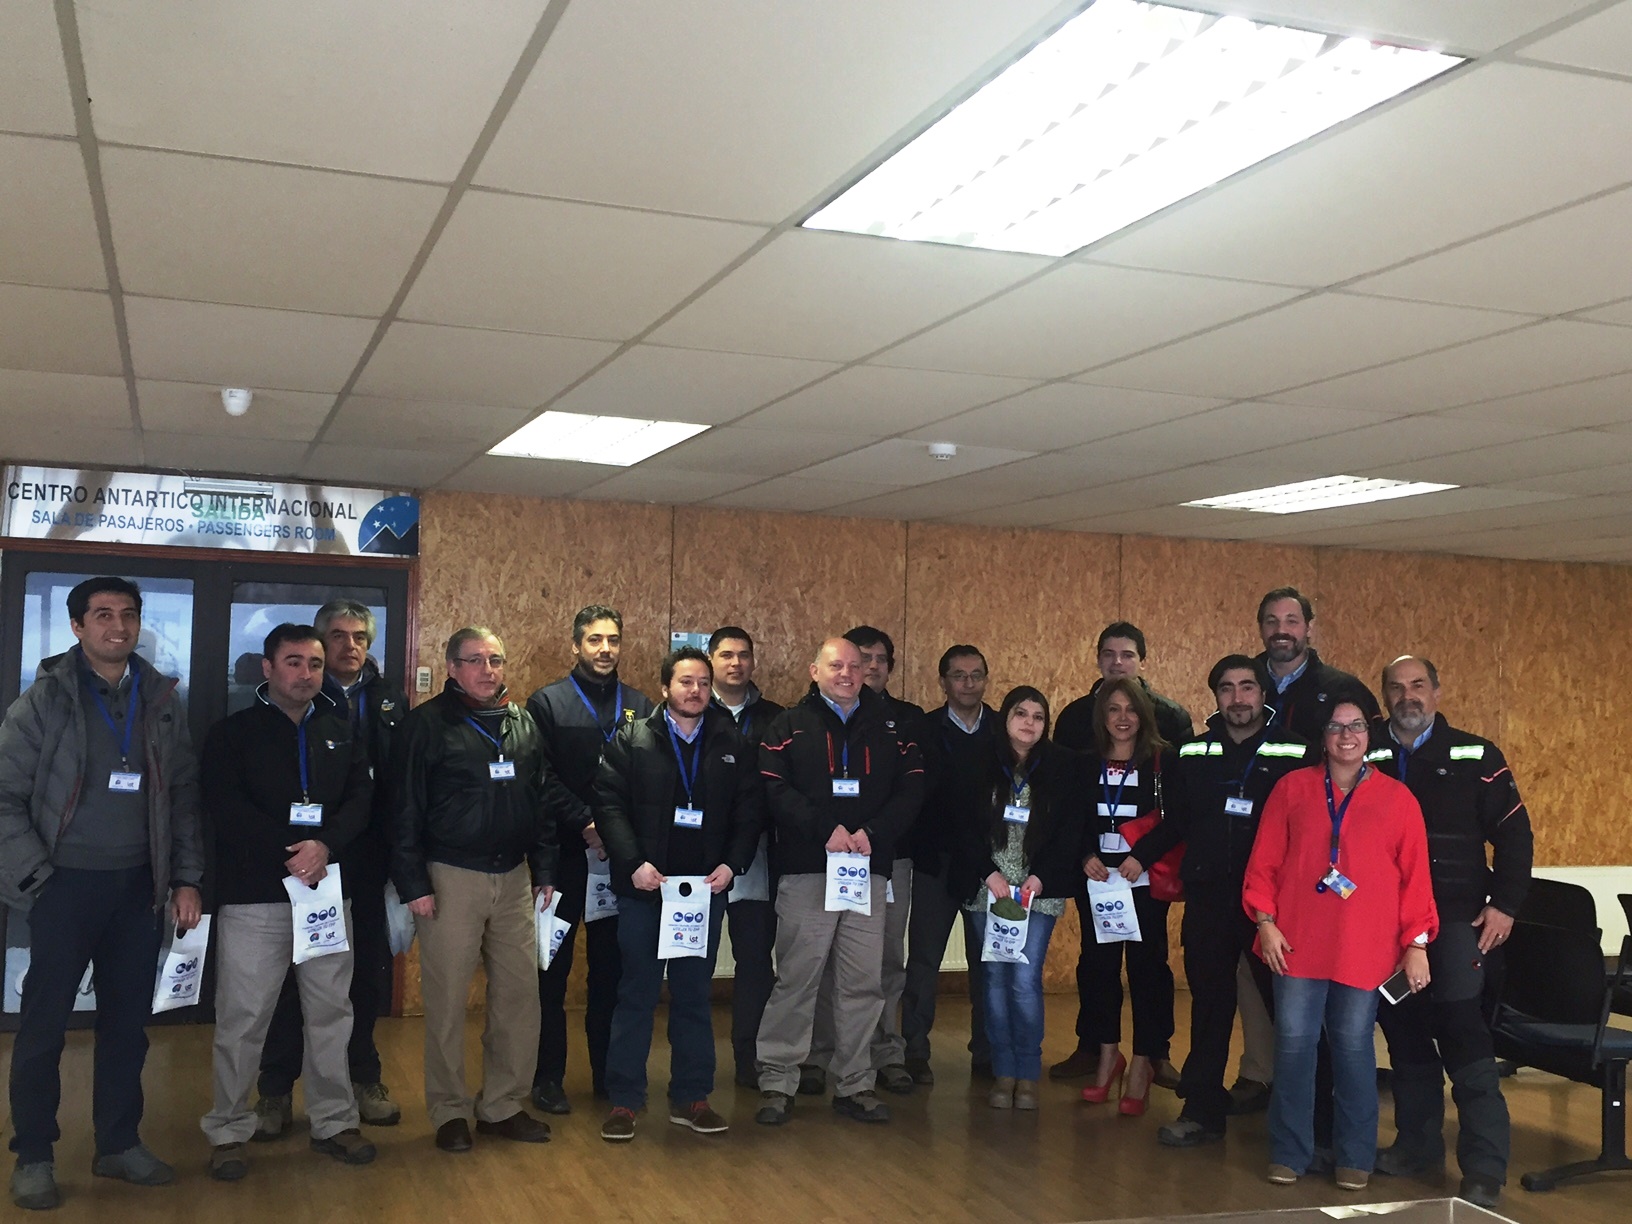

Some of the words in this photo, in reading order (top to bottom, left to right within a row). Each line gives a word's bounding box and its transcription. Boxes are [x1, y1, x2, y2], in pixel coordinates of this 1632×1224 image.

[8, 481, 88, 503] CENTRO
[93, 487, 204, 511] ANTARTICO
[210, 494, 357, 520] INTERNACIONAL
[191, 503, 266, 521] SALIDA
[31, 510, 71, 526] SALA
[75, 513, 94, 527] DE
[99, 514, 184, 533] PASAJEROS
[197, 520, 291, 540] PASSENGERS
[294, 527, 336, 541] ROOM
